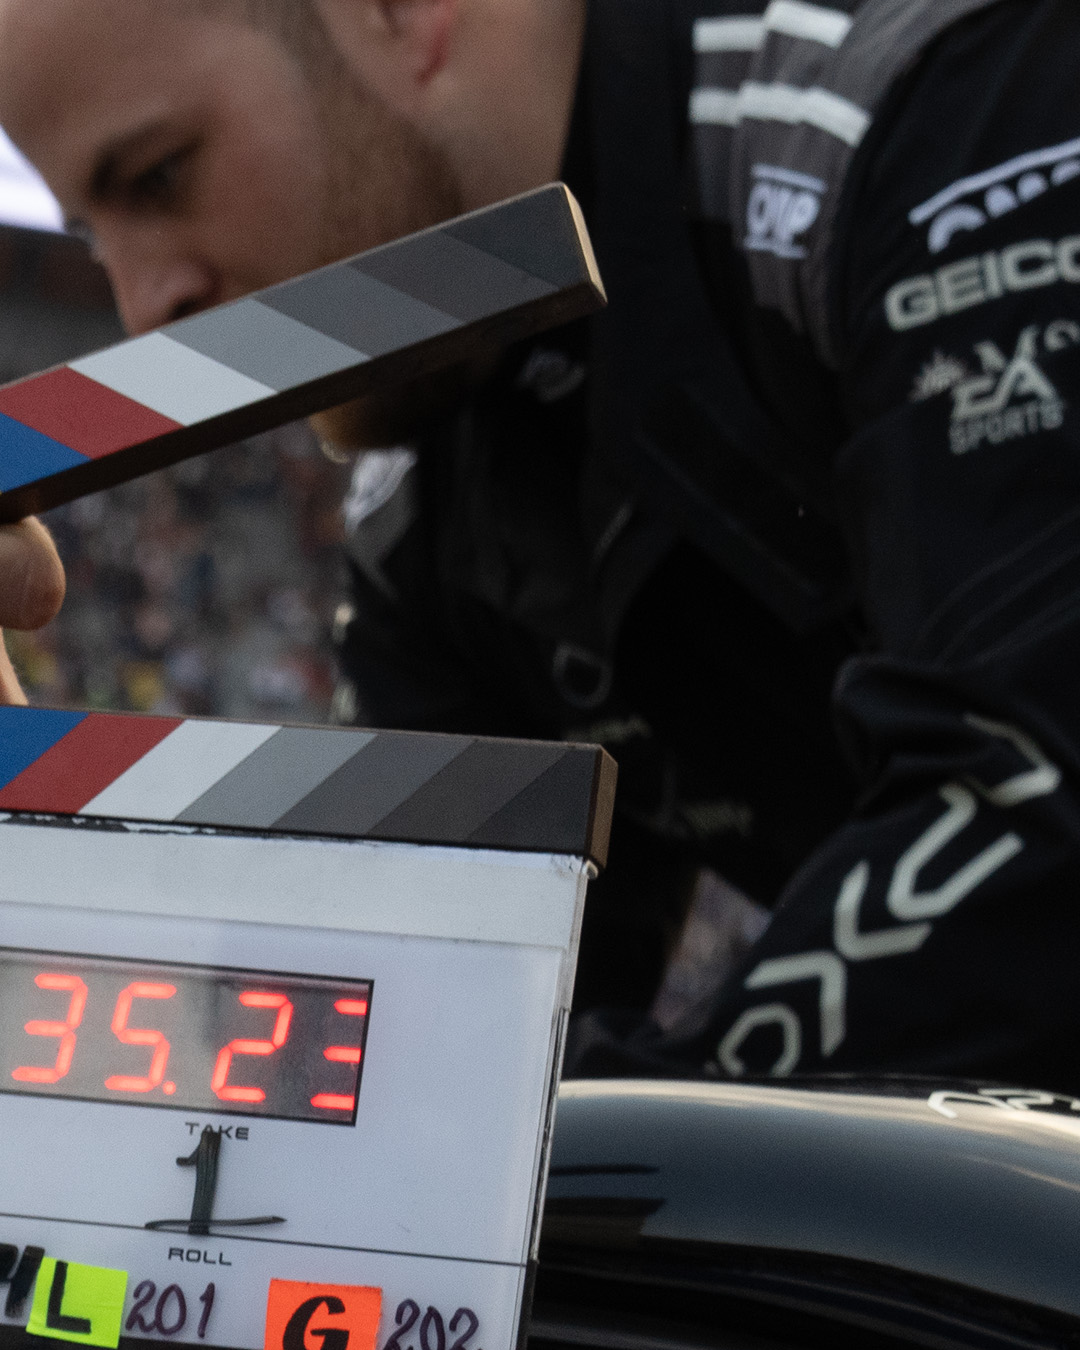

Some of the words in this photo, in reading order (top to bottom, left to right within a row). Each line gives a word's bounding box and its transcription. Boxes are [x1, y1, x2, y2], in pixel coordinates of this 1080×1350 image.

[949, 400, 1064, 455] SPORTS
[185, 1121, 251, 1141] TAKE
[145, 1128, 287, 1237] 1
[168, 1246, 233, 1267] ROLL
[45, 1260, 92, 1335] L
[125, 1279, 217, 1339] 201
